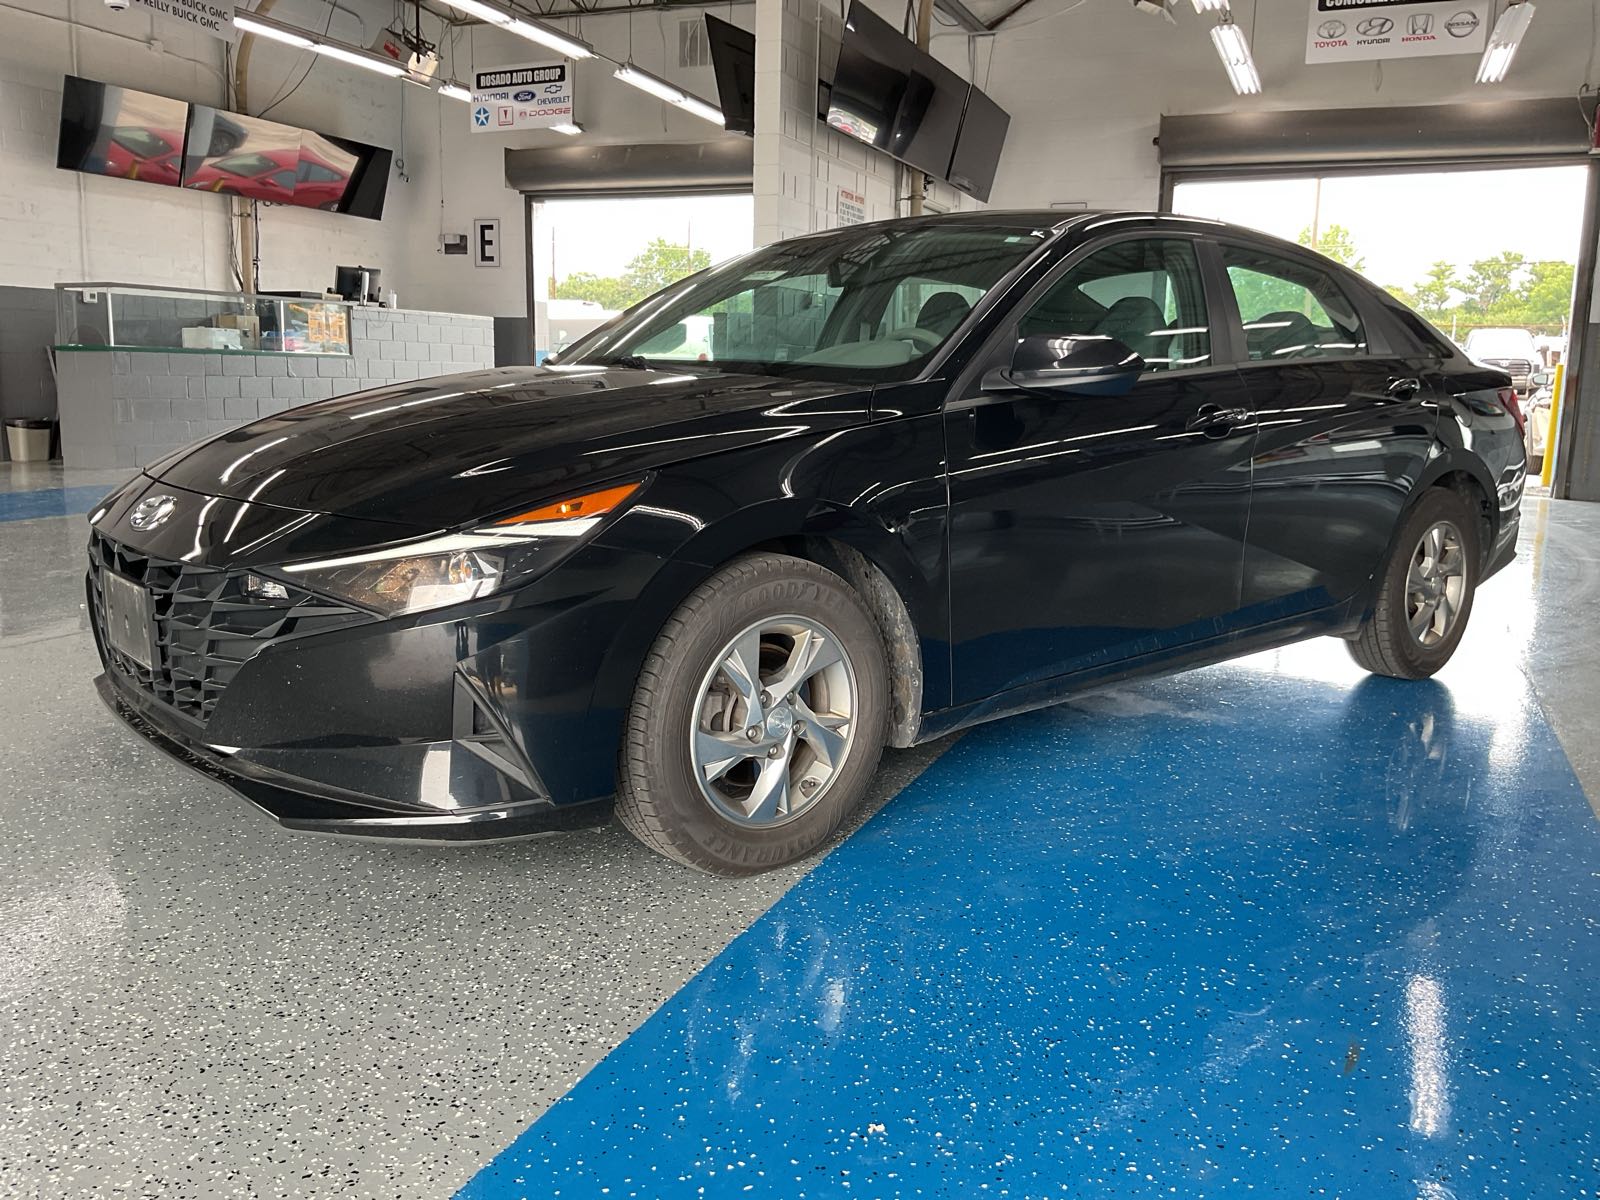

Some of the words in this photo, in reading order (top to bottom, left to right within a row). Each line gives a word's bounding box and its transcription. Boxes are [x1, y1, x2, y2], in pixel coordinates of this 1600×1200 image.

[181, 0, 207, 14] BUICK
[208, 6, 229, 21] GMC
[172, 6, 198, 23] BUICK
[200, 16, 220, 31] GMC
[1447, 19, 1478, 27] NISSAN
[1356, 37, 1391, 45] HYUNDAI
[1401, 34, 1437, 42] HONDA
[1314, 39, 1348, 49] TOYOTA
[480, 73, 511, 87] ROSADO
[512, 70, 533, 84] AUTO
[534, 68, 561, 82] GROUP
[473, 92, 509, 103] HYUNDAI
[537, 96, 570, 106] CHEVROLET
[529, 107, 571, 117] DODGE
[480, 224, 494, 262] E
